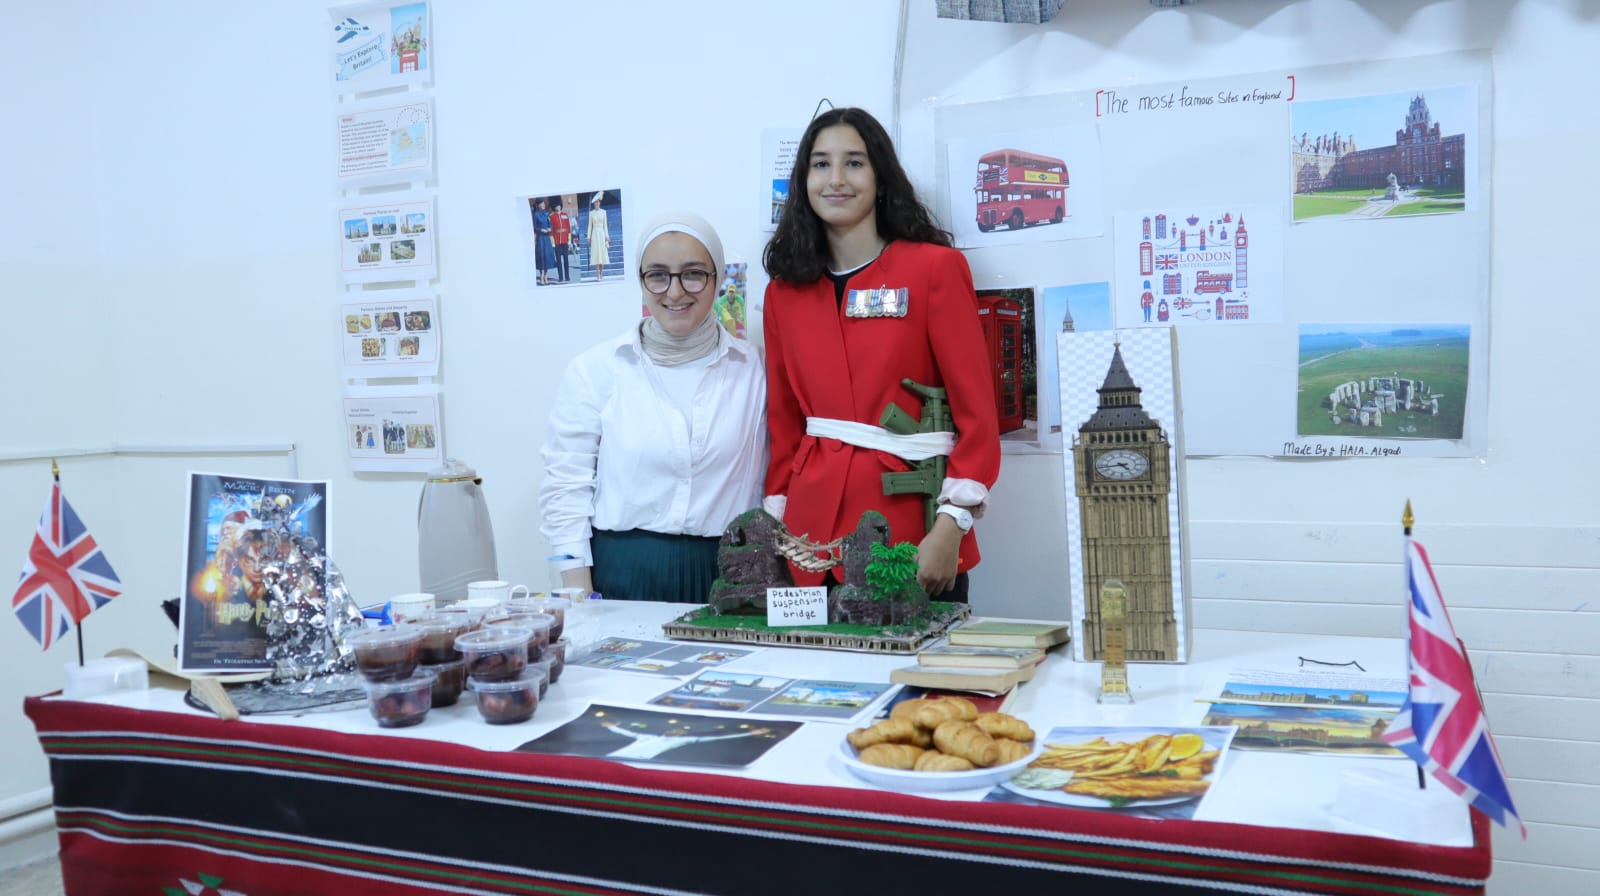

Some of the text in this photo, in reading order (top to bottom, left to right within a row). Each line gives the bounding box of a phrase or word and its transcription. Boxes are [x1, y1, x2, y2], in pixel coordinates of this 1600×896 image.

[343, 54, 357, 65] Let's
[1138, 93, 1175, 111] most
[1177, 85, 1214, 107] famous
[1217, 91, 1239, 104] Sites
[1180, 251, 1232, 263] LONDON
[1283, 442, 1312, 455] Made
[772, 597, 824, 609] suspension
[783, 610, 816, 620] bridge
